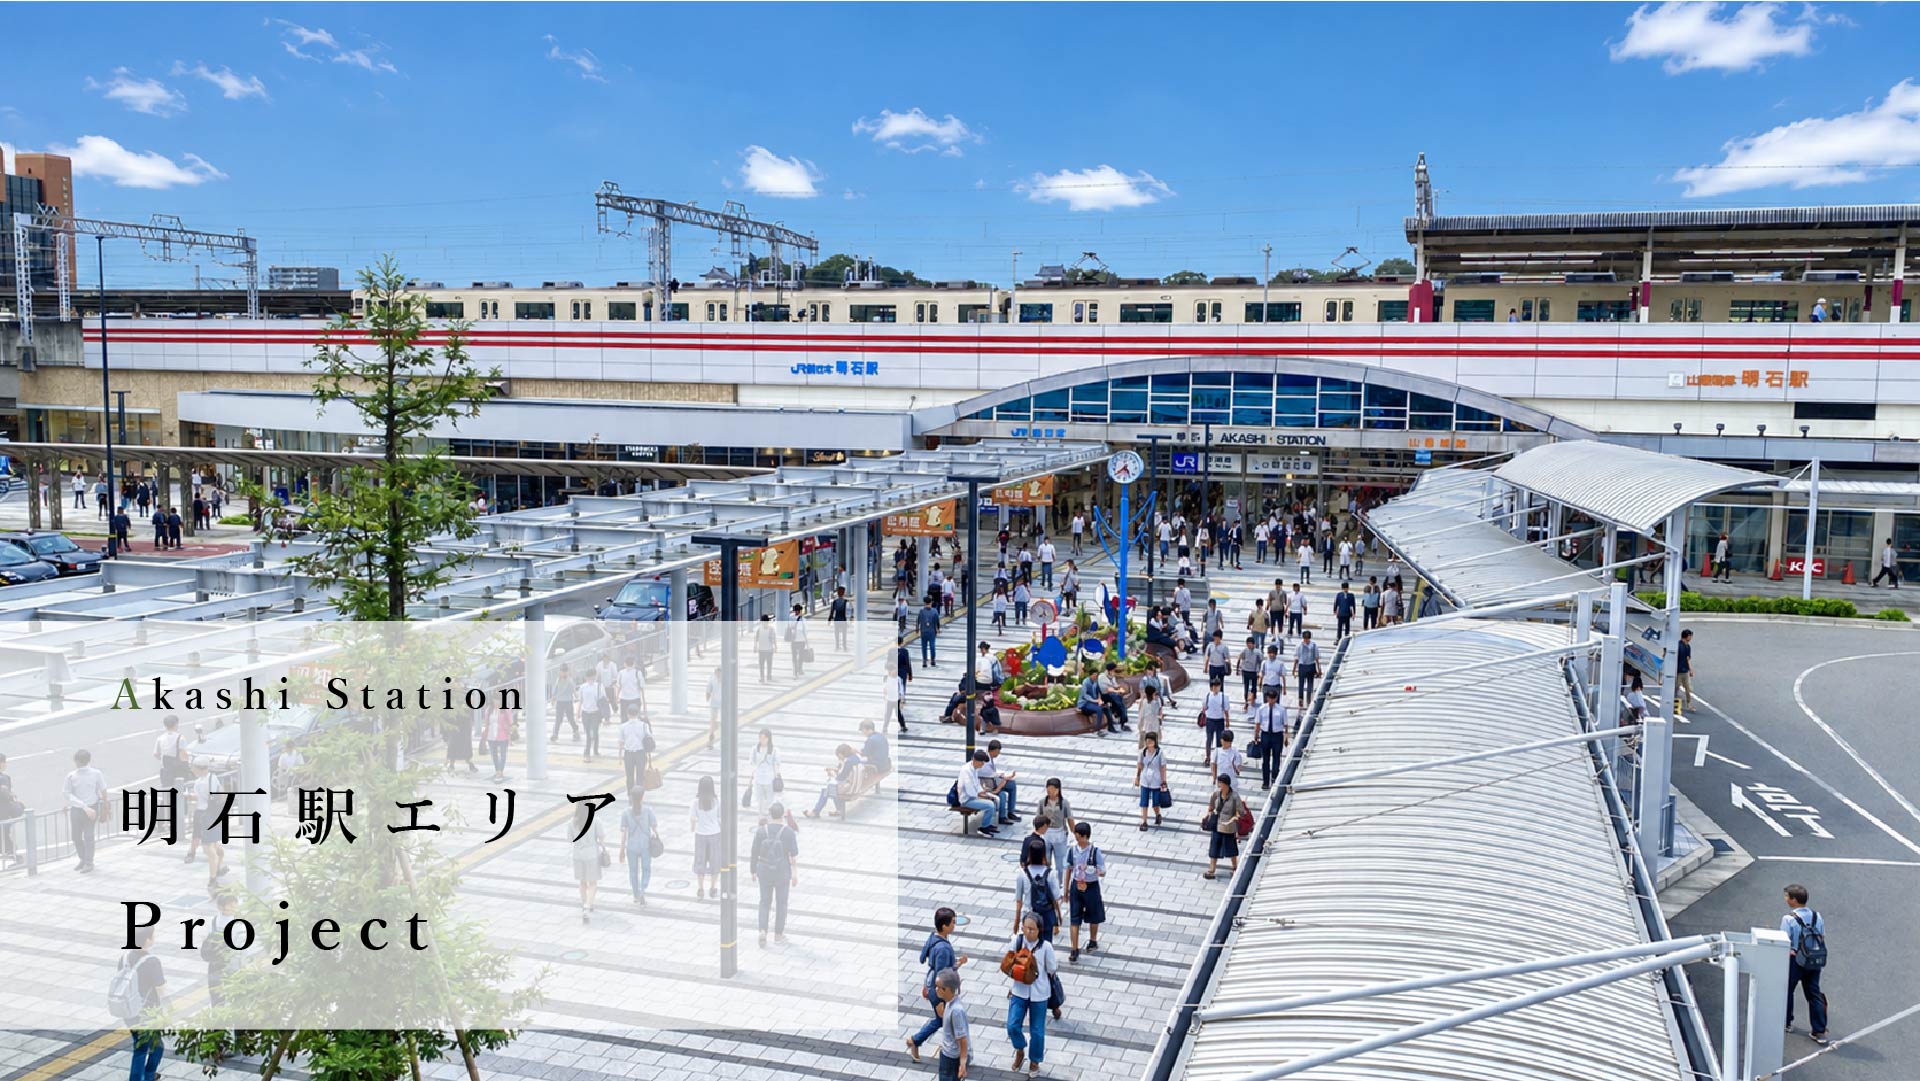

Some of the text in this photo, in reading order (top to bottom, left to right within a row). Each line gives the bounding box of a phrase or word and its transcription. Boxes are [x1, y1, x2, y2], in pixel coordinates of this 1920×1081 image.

[1220, 432, 1266, 445] AKASHI
[1276, 434, 1326, 446] STATION
[1175, 455, 1196, 468] JR
[1789, 561, 1822, 573] KC
